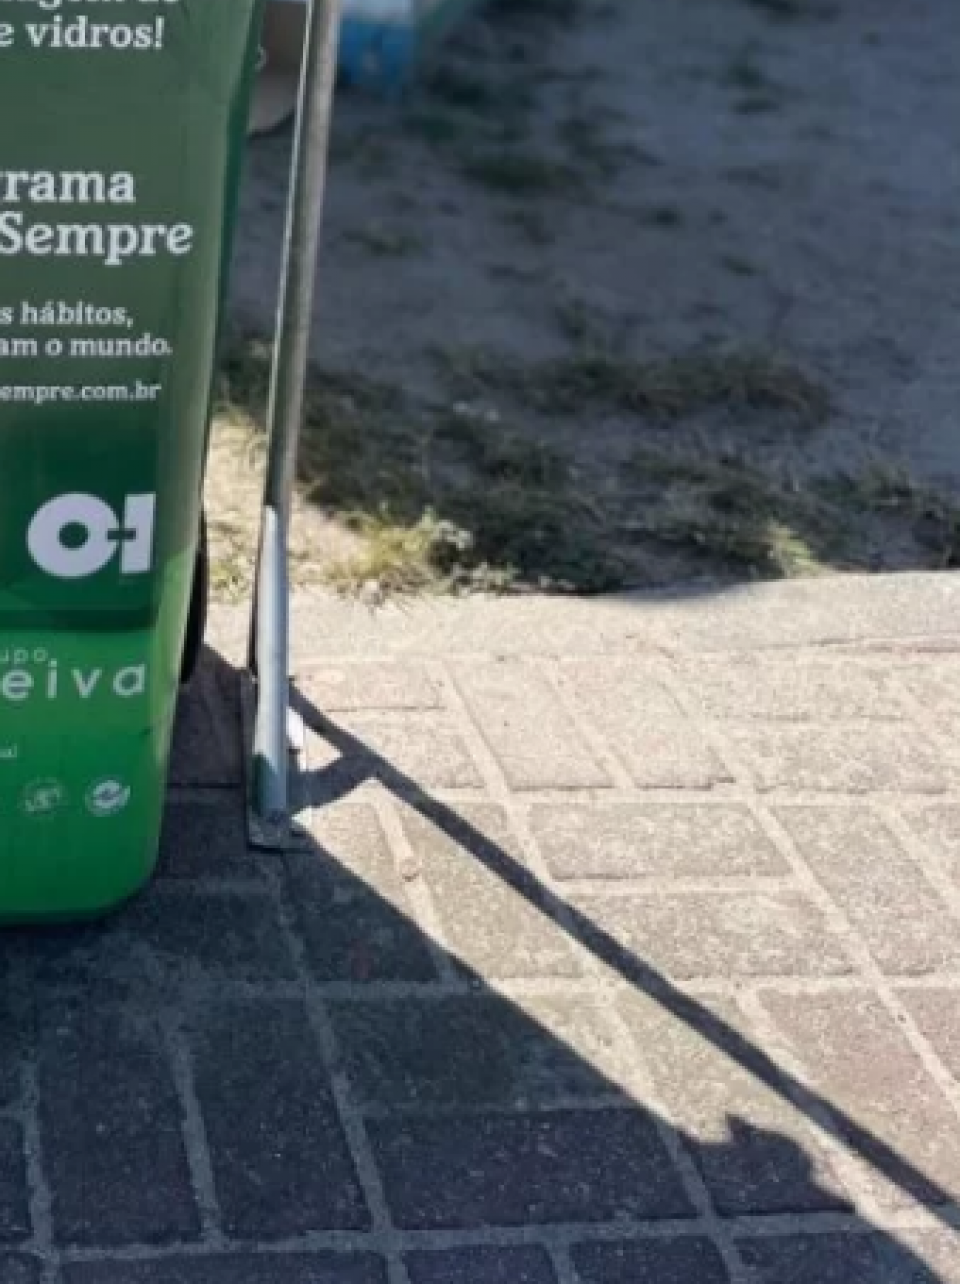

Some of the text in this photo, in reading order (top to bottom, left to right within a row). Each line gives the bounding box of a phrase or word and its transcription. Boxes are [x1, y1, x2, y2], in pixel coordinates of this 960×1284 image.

[25, 16, 165, 49] vidros!
[21, 301, 134, 329] hábitos,
[45, 337, 63, 356] o
[70, 333, 172, 357] mundo.
